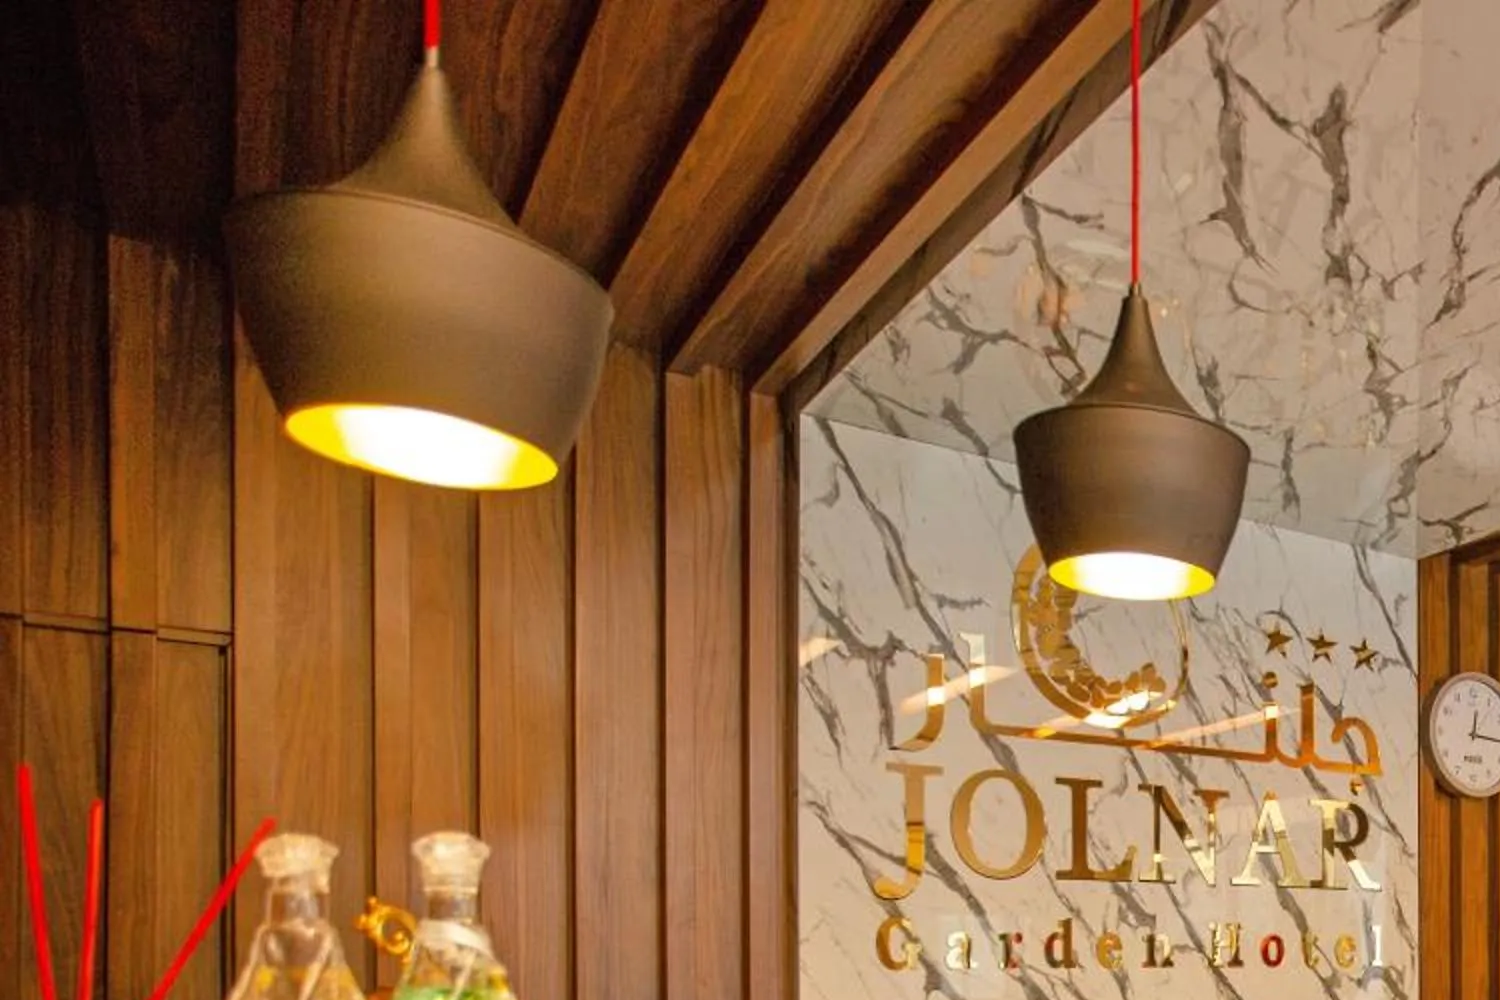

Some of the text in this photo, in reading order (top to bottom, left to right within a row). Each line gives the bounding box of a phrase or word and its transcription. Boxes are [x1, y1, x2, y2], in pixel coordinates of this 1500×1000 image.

[871, 762, 1382, 900] JOLNAR
[875, 915, 1384, 971] Garden Hotel
